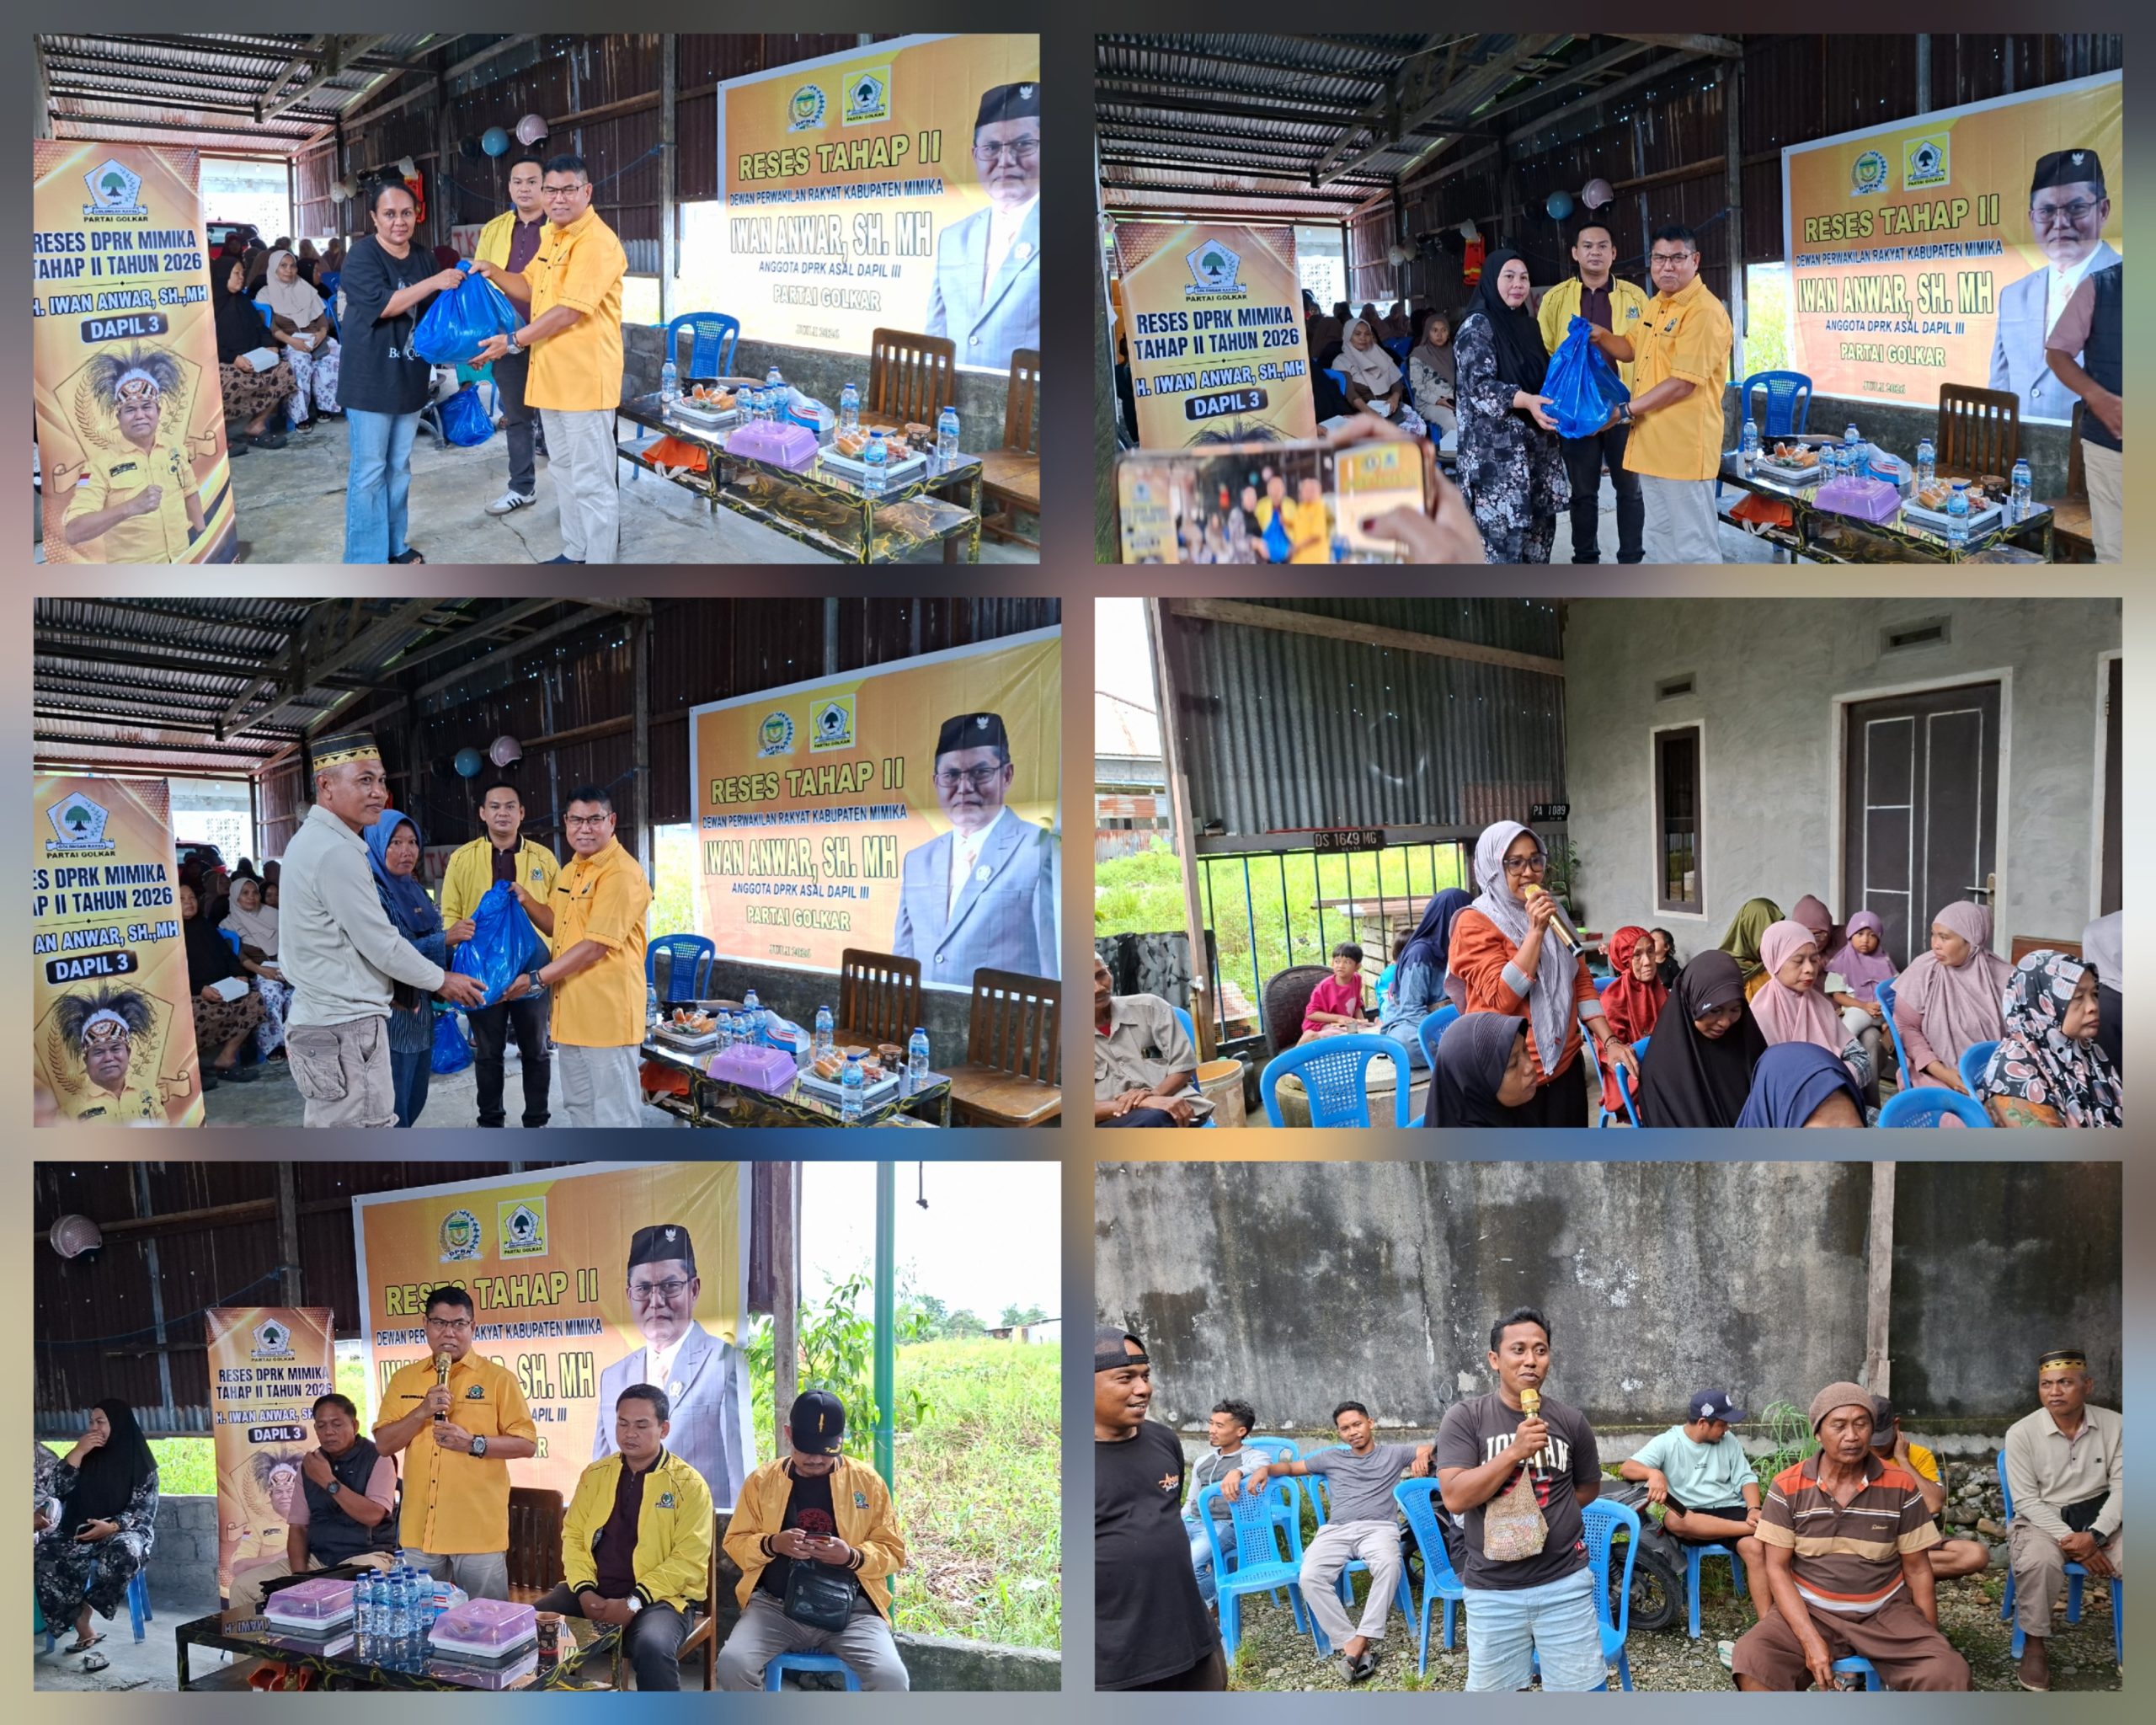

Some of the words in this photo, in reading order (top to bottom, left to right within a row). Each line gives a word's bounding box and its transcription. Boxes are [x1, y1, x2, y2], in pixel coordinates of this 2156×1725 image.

[739, 147, 809, 181] RESES
[816, 134, 910, 174] TAHAP
[919, 130, 942, 163] II
[729, 191, 755, 206] DEWAN
[756, 188, 806, 205] PERWAKILAN
[808, 185, 842, 202] RAKYAT
[844, 181, 902, 200] KABUPATEN
[904, 179, 944, 196] MIMIKA
[1805, 211, 1874, 243] RESES
[1880, 198, 1969, 235] TAHAP
[1977, 194, 1999, 226] II
[34, 232, 85, 253] RESES
[91, 231, 133, 251] DPRK
[138, 230, 196, 248] MIMIKA
[730, 216, 772, 254] IWAN
[776, 215, 849, 264] ANWAR,
[852, 213, 889, 256] SH.
[895, 211, 932, 256] MH
[91, 256, 102, 275] II
[107, 254, 158, 275] TAHUN
[164, 253, 201, 272] 2026
[1796, 253, 1821, 268] DEWAN
[1822, 249, 1871, 266] PERWAKILAN
[1872, 247, 1905, 264] RAKYAT
[1907, 243, 1962, 261] KABUPATEN
[1965, 240, 2003, 257] MIMIKA
[759, 261, 799, 274] ANGGOTA
[802, 262, 826, 275] DPRK
[828, 263, 854, 276] ASAL
[857, 264, 888, 277] DAPIL
[891, 264, 901, 278] III
[50, 293, 93, 315] IWAN
[97, 288, 156, 311] ANWAR,
[158, 286, 208, 308] SH.,MH
[773, 285, 818, 306] PARTAI
[820, 287, 882, 312] GOLKAR
[1798, 277, 1838, 313] IWAN
[1843, 275, 1913, 322] ANWAR,
[1917, 273, 1952, 314] SH.
[1958, 271, 1993, 314] MH
[90, 318, 145, 339] DAPIL
[149, 317, 160, 332] 3
[1136, 311, 1188, 334] RESES
[1193, 309, 1234, 331] DPRK
[1237, 306, 1294, 328] MIMIKA
[1826, 319, 1865, 332] ANGGOTA
[1867, 320, 1892, 333] DPRK
[1894, 321, 1919, 334] ASAL
[1922, 321, 1952, 334] DAPIL
[1955, 322, 1965, 334] III
[1134, 337, 1187, 360] TAHAP
[1194, 335, 1204, 355] II
[1209, 332, 1259, 354] TAHUN
[1262, 328, 1299, 348] 2026
[1840, 343, 1884, 363] PARTAI
[1887, 345, 1945, 367] GOLKAR
[1135, 379, 1151, 398] H.
[1155, 373, 1197, 395] IWAN
[1199, 366, 1256, 389] ANWAR,
[1258, 360, 1305, 382] SH.,MH
[1193, 393, 1246, 417] DAPIL
[1250, 392, 1260, 408] 3
[711, 772, 779, 804] RESES
[786, 761, 875, 797] TAHAP
[883, 757, 905, 789] II
[702, 814, 728, 830] DEWAN
[728, 811, 776, 828] PERWAKILAN
[778, 809, 810, 826] RAKYAT
[812, 806, 867, 824] KABUPATEN
[869, 803, 907, 820] MIMIKA
[1533, 805, 1543, 816] PA
[1315, 833, 1330, 847] DS
[1334, 832, 1360, 846] 1649
[1363, 831, 1377, 844] MG
[704, 841, 744, 877] IWAN
[749, 838, 819, 884] ANWAR,
[822, 836, 857, 878] SH.
[862, 836, 898, 879] MH
[55, 866, 100, 889] DPRK
[104, 864, 167, 884] MIMIKA
[55, 894, 67, 915] II
[72, 889, 127, 913] TAHUN
[132, 887, 173, 907] 2026
[732, 883, 771, 895] ANGGOTA
[773, 884, 798, 896] DPRK
[799, 884, 825, 898] ASAL
[827, 885, 857, 899] DAPIL
[860, 886, 869, 900] III
[746, 905, 789, 927] PARTAI
[792, 908, 851, 932] GOLKAR
[61, 927, 125, 951] ANWAR,
[129, 920, 179, 943] SH.,MH
[56, 957, 115, 980] DAPIL
[117, 953, 129, 970] 3
[385, 1280, 466, 1316] RES
[474, 1270, 568, 1311] TAHAP
[577, 1268, 599, 1302] II
[376, 1329, 406, 1346] DEWAN
[472, 1324, 503, 1341] AKYAT
[505, 1321, 563, 1339] KABUPATEN
[565, 1318, 603, 1337] MIMIKA
[219, 1368, 253, 1383] RESES
[256, 1367, 284, 1381] DPRK
[288, 1366, 329, 1381] MIMIKA
[517, 1354, 555, 1400] SH.
[559, 1352, 595, 1398] MH
[216, 1386, 252, 1400] TAHAP
[255, 1385, 263, 1398] II
[266, 1384, 302, 1398] TAHUN
[305, 1383, 333, 1397] 2026
[216, 1412, 227, 1424] H.
[229, 1410, 256, 1423] IWAN
[259, 1407, 300, 1423] ANWAR,
[531, 1407, 554, 1421] APIL
[558, 1407, 567, 1421] III
[254, 1429, 291, 1441] DAPIL
[293, 1427, 302, 1439] 3
[1481, 1433, 1569, 1473] JOAN
